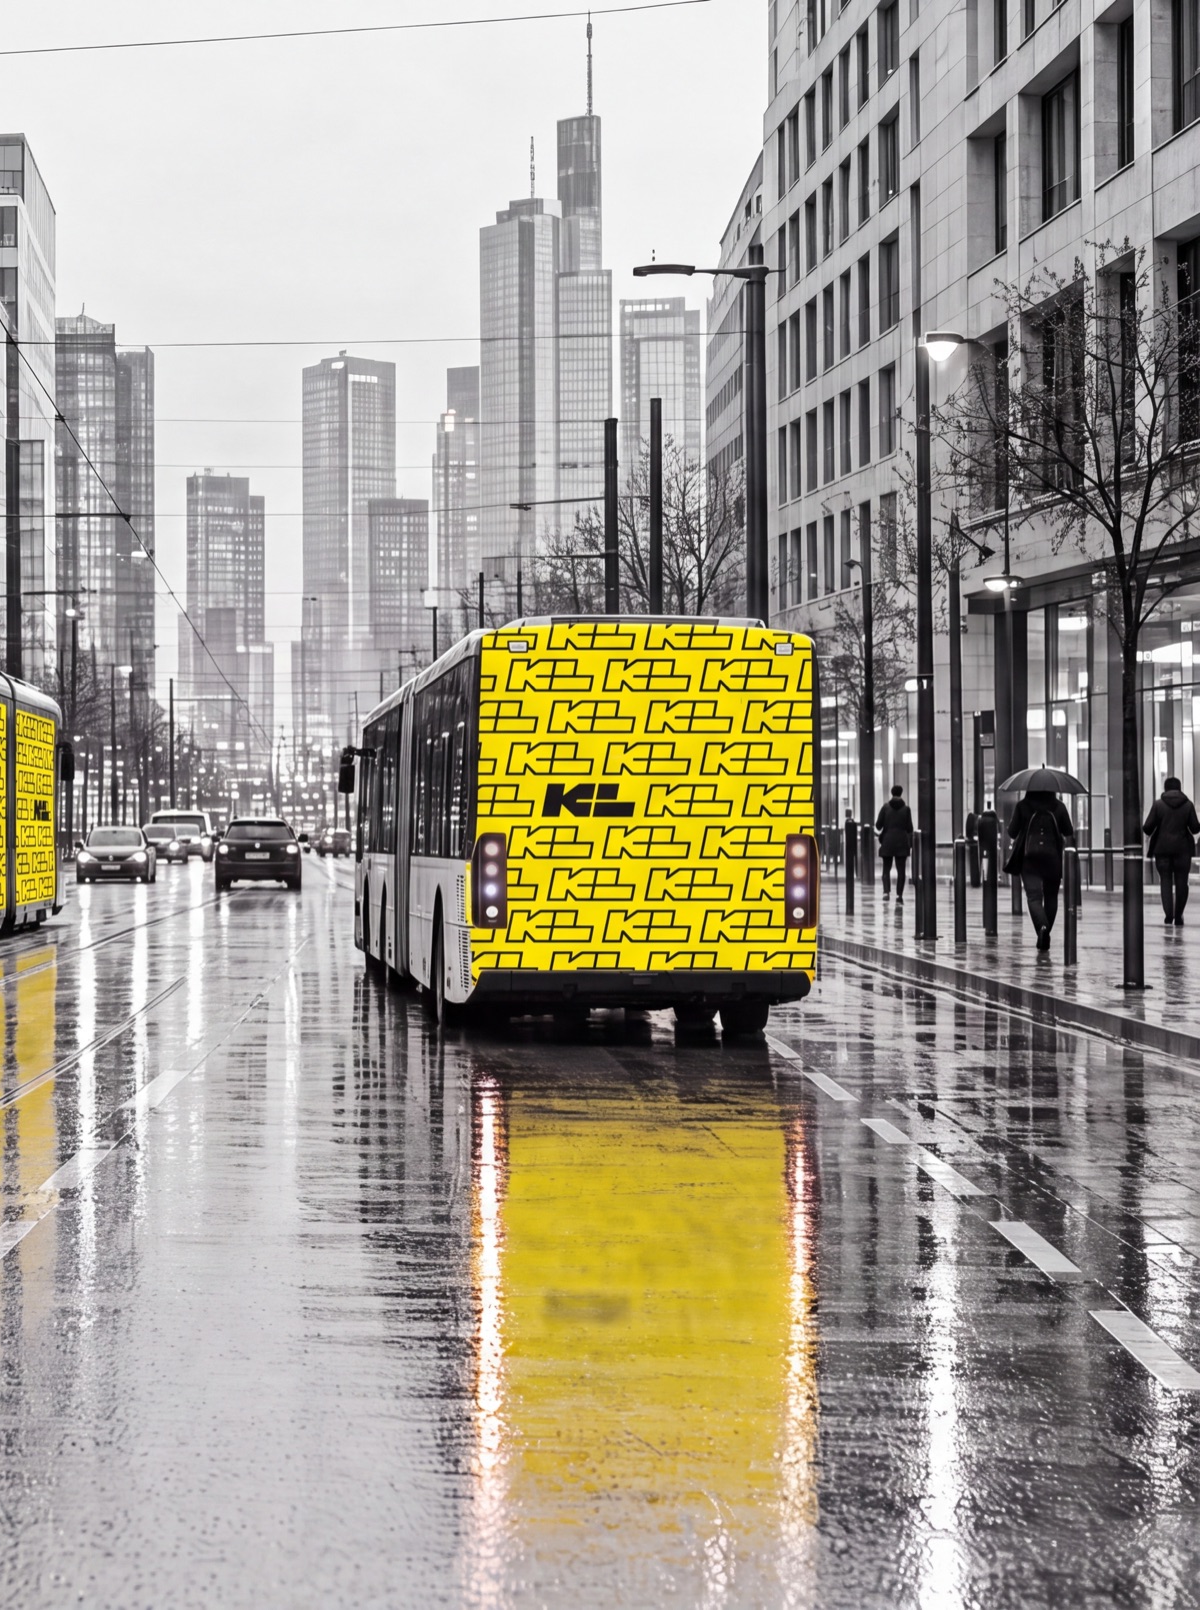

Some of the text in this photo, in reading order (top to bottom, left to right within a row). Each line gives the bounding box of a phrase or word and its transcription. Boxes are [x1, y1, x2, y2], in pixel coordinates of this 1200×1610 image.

[505, 659, 594, 691] KL
[602, 659, 691, 691] KL
[699, 659, 788, 691] KL
[547, 701, 636, 733] KL
[644, 701, 733, 733] KL
[505, 742, 594, 775] KL
[602, 742, 691, 775] KL
[699, 742, 788, 775] KL
[542, 784, 636, 817] KL
[644, 784, 733, 817] KL
[507, 826, 786, 859] KL KL KL
[547, 868, 636, 901] KL
[644, 868, 733, 901] KL
[742, 868, 785, 901] K
[505, 910, 594, 942] KL
[602, 910, 691, 942] KL
[699, 910, 788, 942] KL
